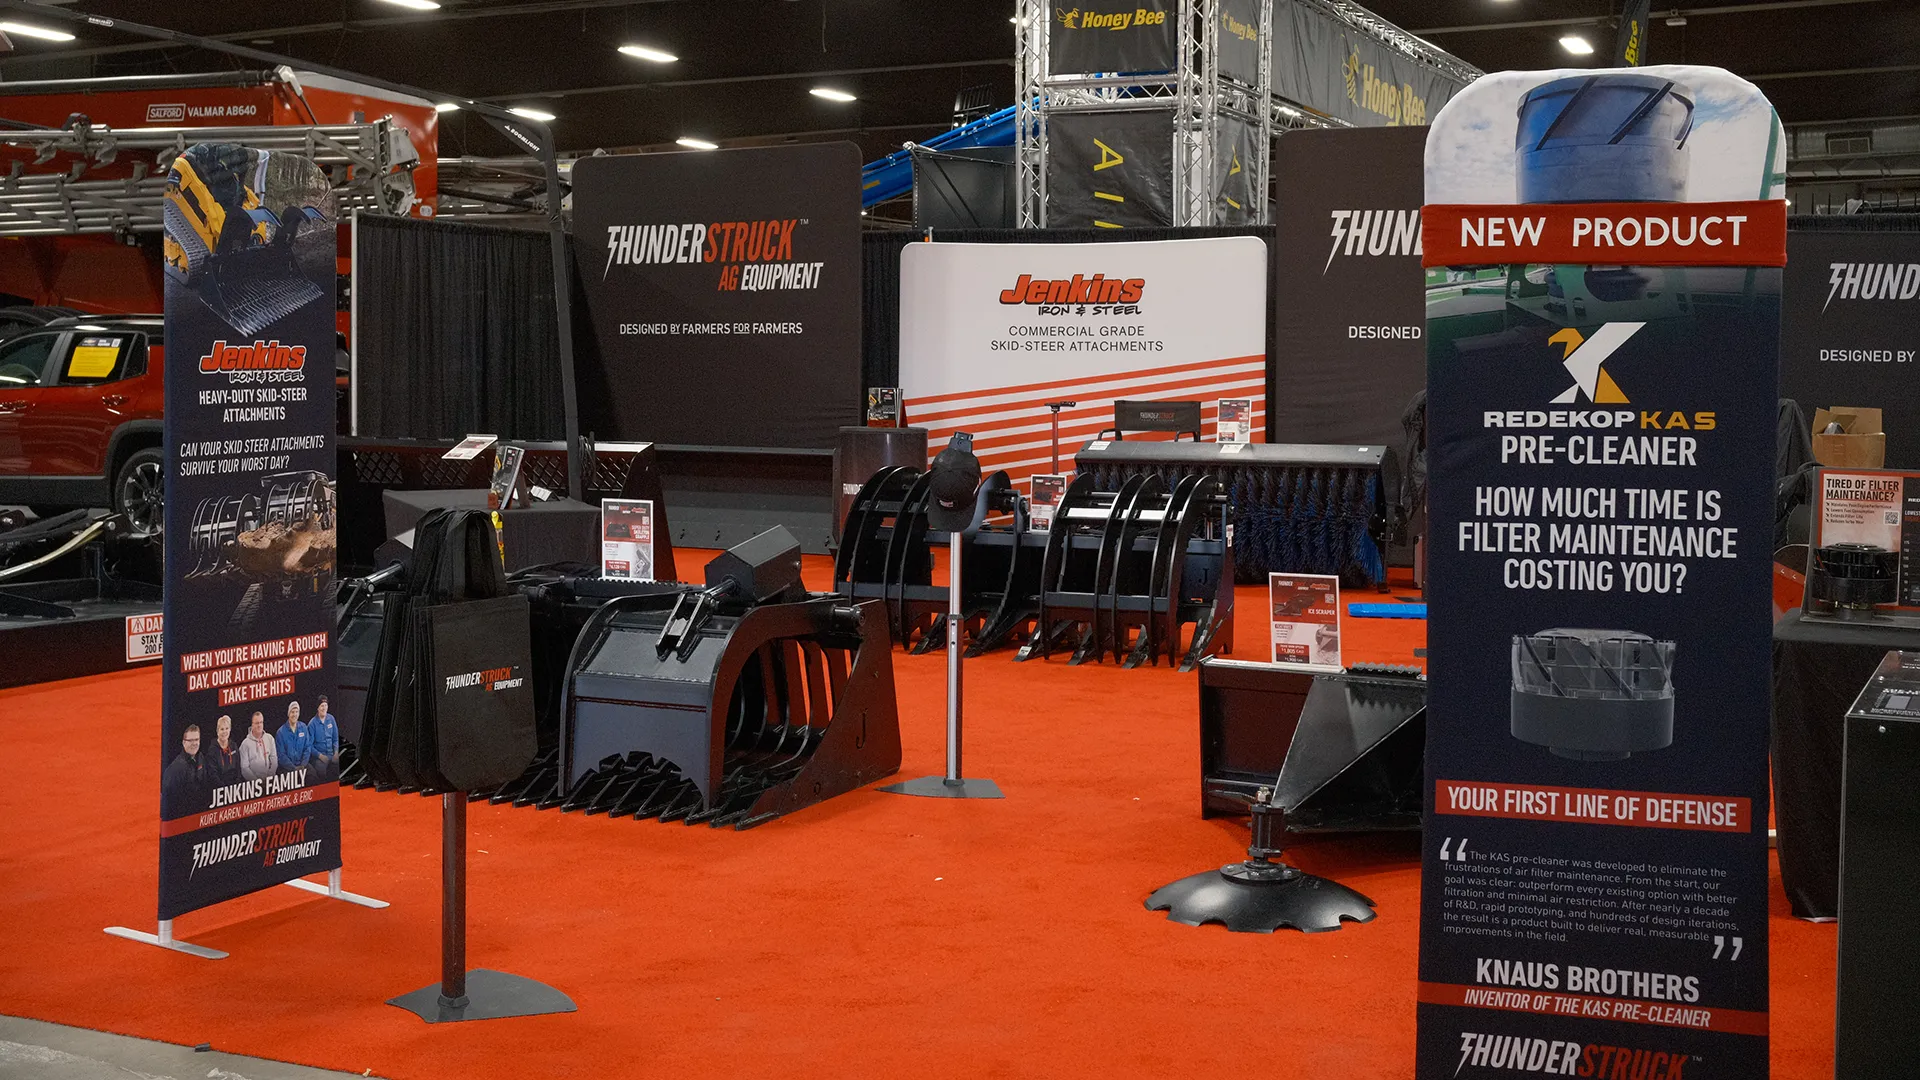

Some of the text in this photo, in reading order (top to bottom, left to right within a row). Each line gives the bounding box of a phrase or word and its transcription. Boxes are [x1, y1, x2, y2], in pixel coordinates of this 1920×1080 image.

[1082, 9, 1165, 30] Honey Bee
[1229, 16, 1246, 40] Honey
[1362, 64, 1425, 126] Honey Bee
[150, 105, 256, 118] SALFORD VALMAR AB640
[1461, 216, 1747, 247] NEW PRODUCT
[602, 219, 797, 281] THUNDERSTRUCK
[718, 262, 824, 291] AG EQUIPMENT
[999, 274, 1145, 305] Jenkins
[1822, 263, 1920, 315] THUND
[1038, 306, 1070, 316] IRON
[1092, 305, 1142, 315] STEEL
[620, 322, 802, 334] DESIGNED BY FARMERS FOR FARMERS
[1009, 326, 1144, 336] COMMERCIAL GRADE
[1348, 326, 1421, 339] DESIGNED
[199, 340, 306, 374] Jenkins
[990, 340, 1163, 351] SKID-STEER ATTACHMENTS
[1820, 350, 1915, 362] DESIGNED BY
[229, 372, 256, 384] IRON
[268, 371, 305, 382] STEEL
[199, 388, 307, 405] HEAVY-DUTY SKID-STEER
[223, 406, 286, 422] ATTACHMENTS
[1484, 411, 1716, 430] REDEKOP KAS
[180, 435, 325, 458] CAN YOUR SKID STEER ATTACHMENTS
[1501, 436, 1697, 466] PRE-CLEANER
[180, 455, 290, 476] SURVIVE YOUR WORST DAY?
[1826, 479, 1899, 491] TIRED OF FILTER
[1826, 490, 1894, 501] MAINTENANCE?
[1476, 487, 1722, 521] HOW MUCH TIME IS
[1459, 522, 1738, 558] FILTER MAINTENANCE
[1504, 559, 1687, 594] COSTING YOU?
[141, 634, 158, 645] STAY
[145, 644, 157, 654] 200
[183, 634, 326, 671] WHEN YOU'RE HAVING A ROUGH
[190, 654, 321, 690] DAY, OUR ATTACHMENTS CAN
[445, 666, 512, 695] THUNDERSTRUCK
[494, 678, 523, 690] EQUIPMENT
[223, 678, 291, 704] TAKE THE HITS
[209, 769, 307, 809] JENKINS FAMILY
[200, 790, 314, 827] KURT, KAREN, MARTY, PATRICK, & ERIC
[1448, 786, 1737, 827] YOUR FIRST LINE OF DEFENSE
[188, 817, 308, 882] THUNDERSTRUCK
[263, 840, 322, 867] AG EQUIPMENT
[1445, 862, 1500, 874] frustrations
[1503, 866, 1513, 874] of
[1515, 868, 1528, 876] air
[1531, 868, 1553, 878] filter
[1557, 871, 1622, 883] maintenance.
[1626, 875, 1652, 885] From
[1655, 877, 1671, 886] the
[1674, 880, 1700, 889] start,
[1470, 851, 1727, 878] The KAS pre-cleaner was developed to eliminate the
[1444, 876, 1464, 885] goal
[1489, 878, 1516, 888] clear:
[1519, 881, 1574, 892] outperform
[1577, 884, 1604, 895] every
[1606, 887, 1645, 899] existing
[1648, 890, 1679, 901] option
[1682, 892, 1703, 902] with
[1707, 894, 1737, 904] better
[1444, 888, 1484, 898] filtration
[1487, 891, 1505, 899] and
[1508, 893, 1547, 903] minimal
[1550, 896, 1563, 904] air
[1566, 897, 1619, 908] restriction.
[1622, 901, 1645, 910] After
[1650, 902, 1681, 914] nearly
[1693, 906, 1729, 917] decade
[1456, 900, 1739, 931] R&D, rapid prototyping, and hundreds design iterations,
[1477, 958, 1699, 1003] KNAUS BROTHERS
[1464, 989, 1711, 1027] INVENTOR OF THE KAS PRE-CLEANER
[1454, 1032, 1688, 1080] THUNDERSTRUCK
